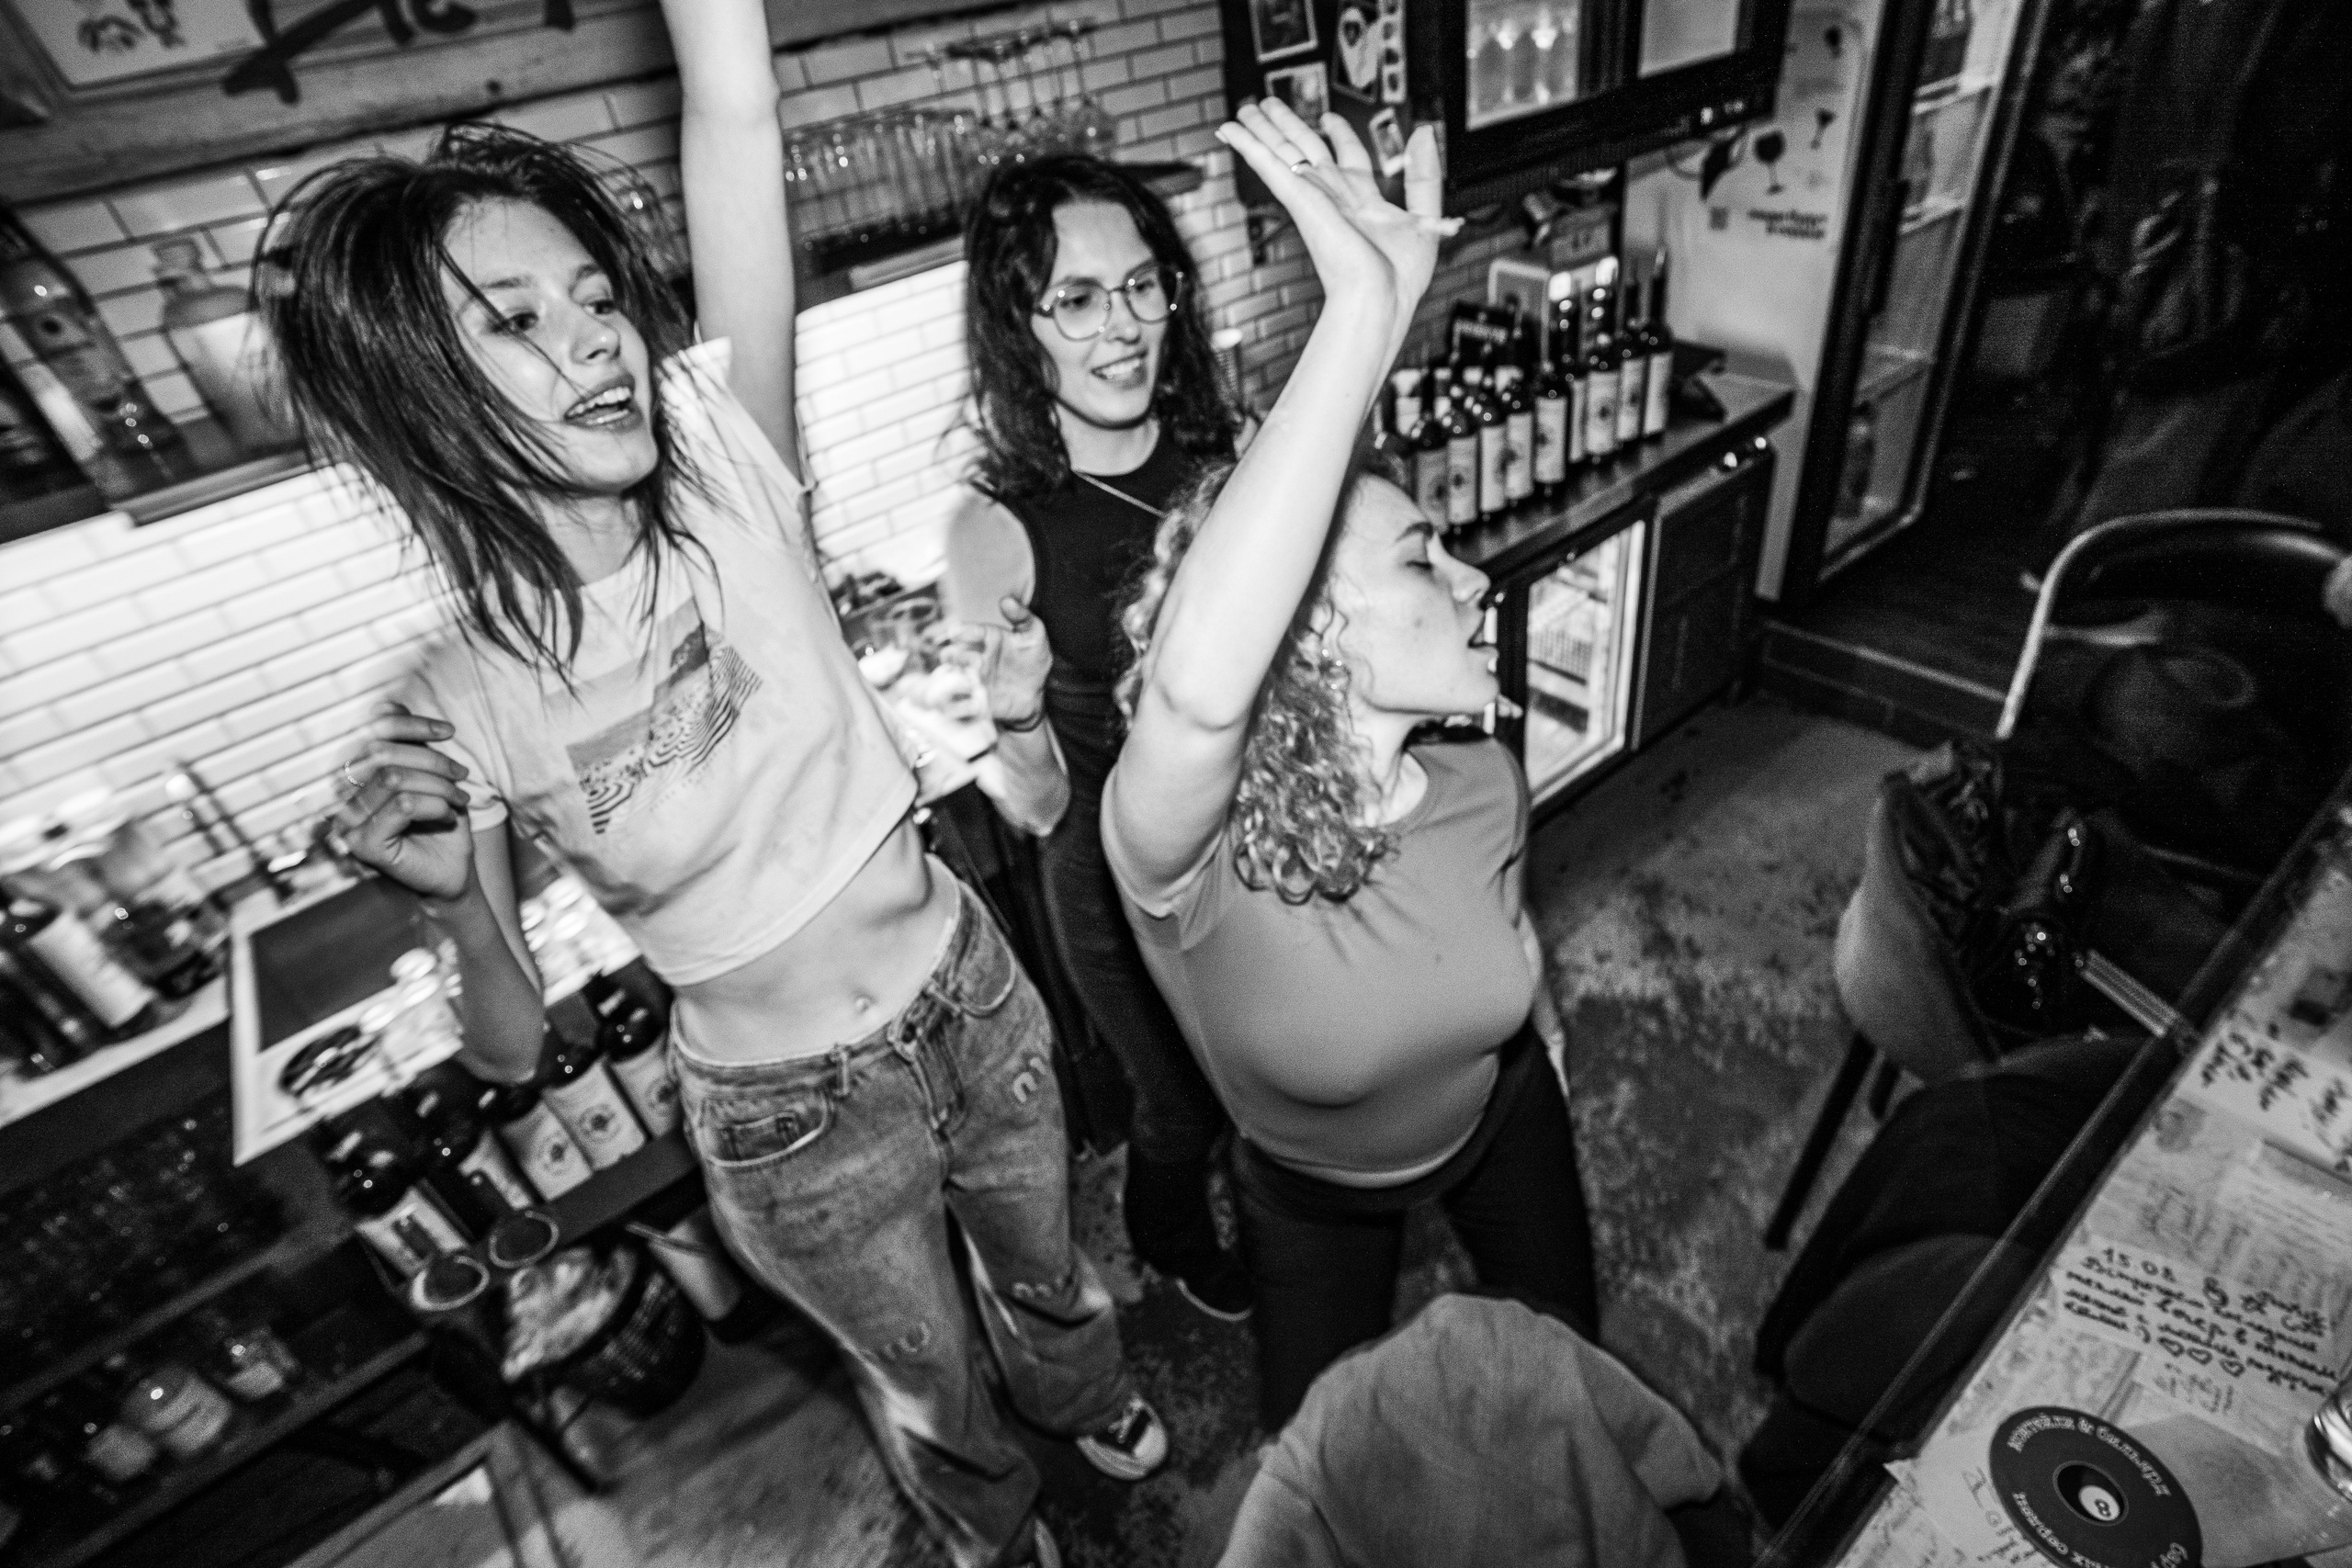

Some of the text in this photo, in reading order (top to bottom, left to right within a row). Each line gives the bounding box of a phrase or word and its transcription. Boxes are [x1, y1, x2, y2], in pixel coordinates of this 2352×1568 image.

[2078, 1417, 2096, 1436] &
[2097, 1426, 2171, 1496] бильярд
[2095, 1499, 2109, 1516] 8
